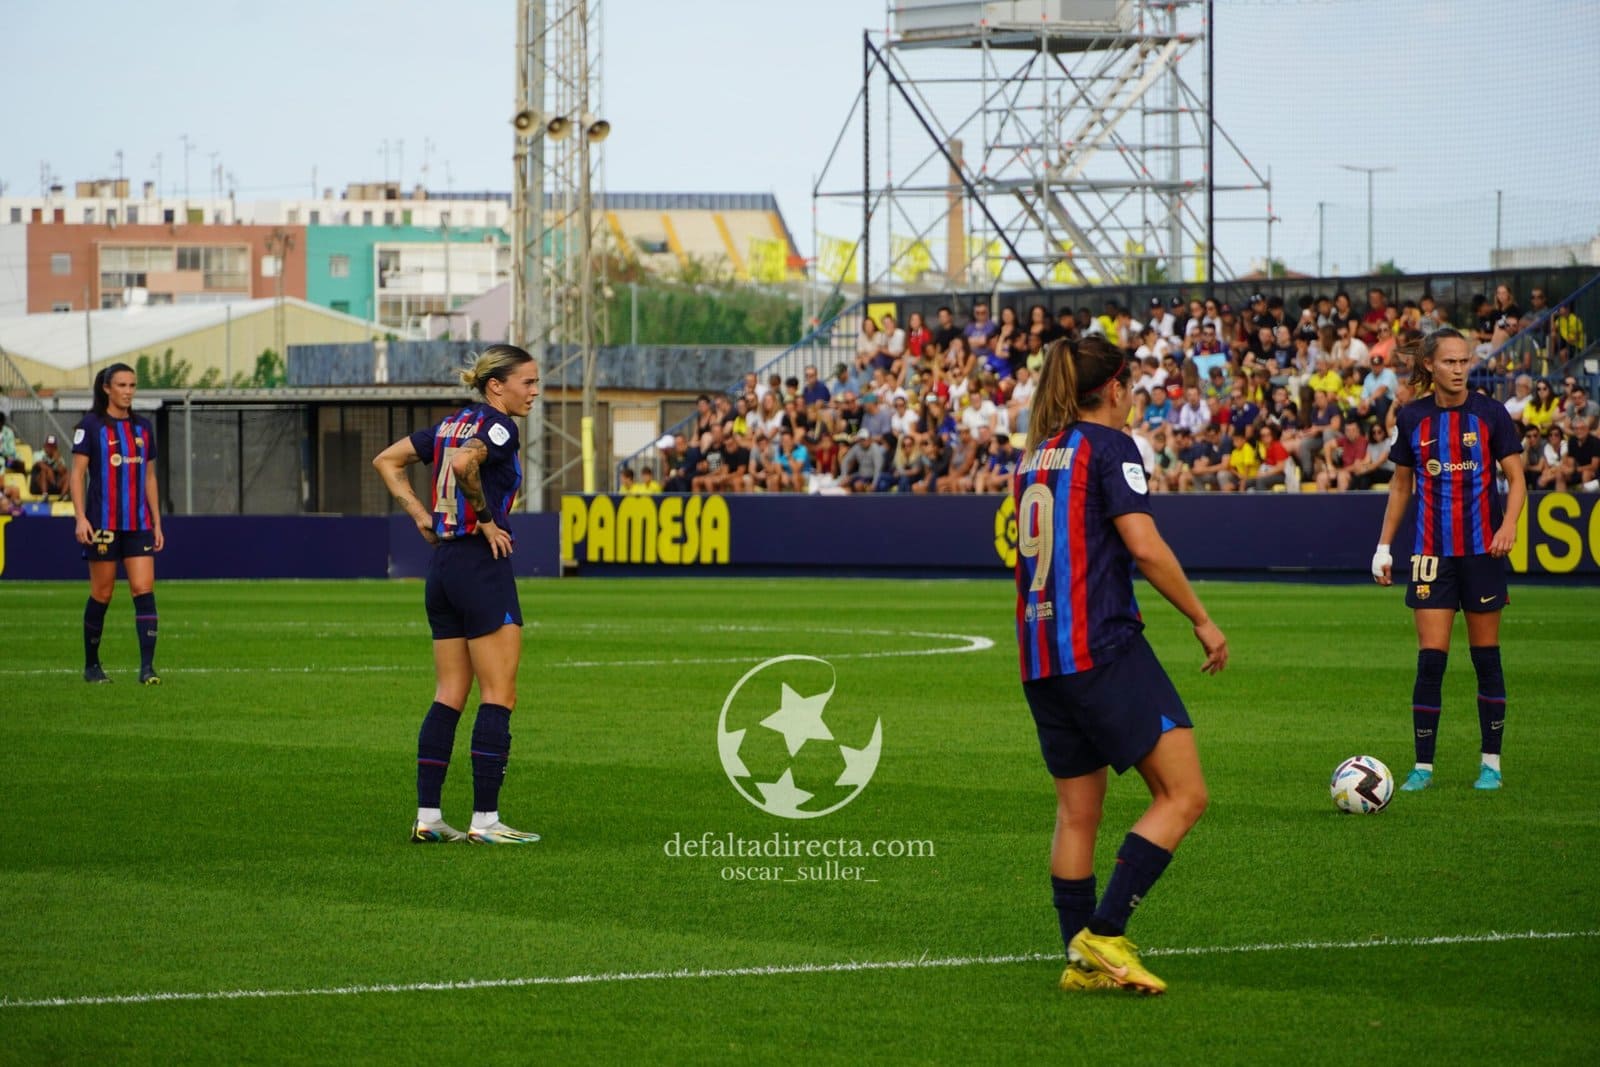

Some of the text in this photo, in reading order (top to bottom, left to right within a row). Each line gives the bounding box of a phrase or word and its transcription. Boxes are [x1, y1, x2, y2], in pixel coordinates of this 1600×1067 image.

[434, 447, 460, 525] 4
[1443, 460, 1479, 472] Spotify
[561, 494, 730, 564] PAMESA
[1019, 483, 1054, 592] 9
[1410, 555, 1439, 582] 10
